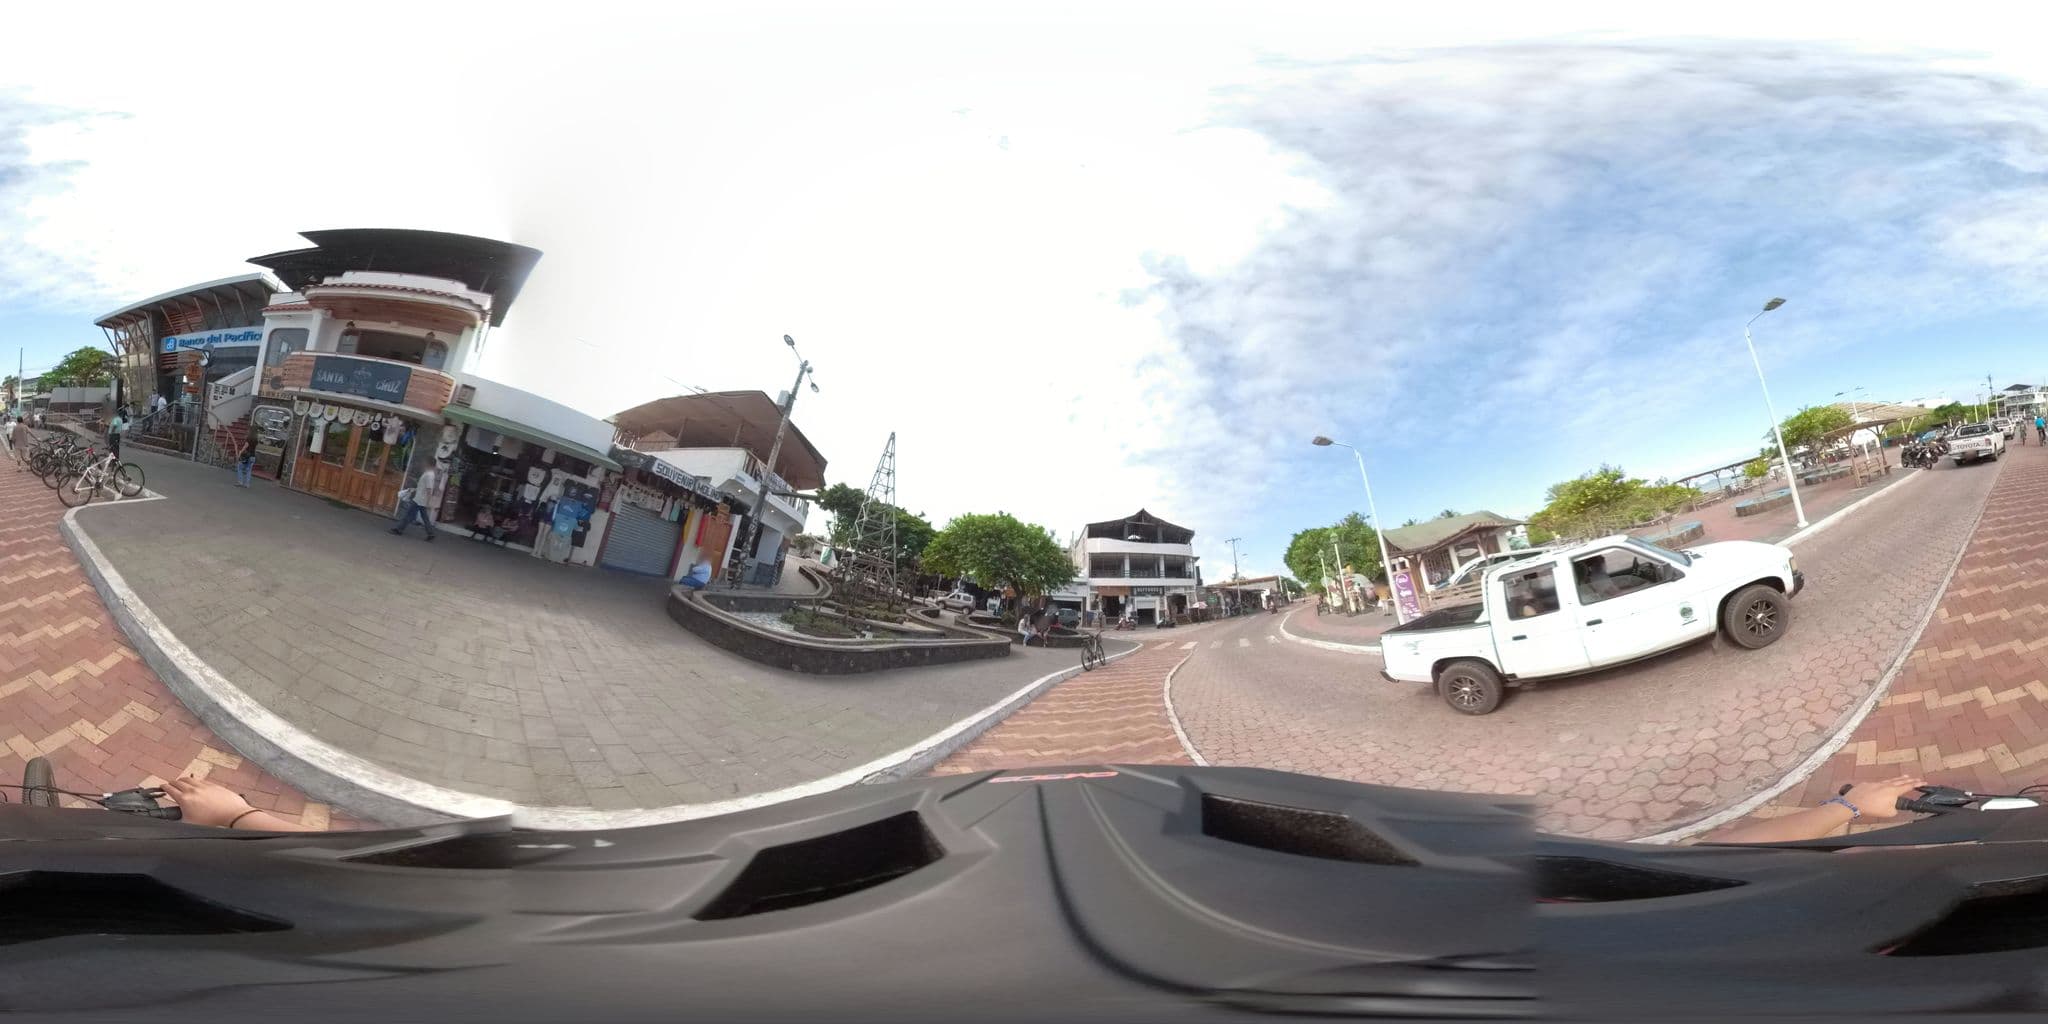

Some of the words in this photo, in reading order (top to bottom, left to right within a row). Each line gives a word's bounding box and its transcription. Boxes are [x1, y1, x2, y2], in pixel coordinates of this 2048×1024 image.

[178, 337, 205, 347] Banco
[207, 333, 222, 344] del
[316, 369, 345, 385] SANTA
[375, 380, 402, 394] CRUZ
[1956, 442, 1981, 450] TOYOTA
[656, 462, 695, 490] SOUVENIR
